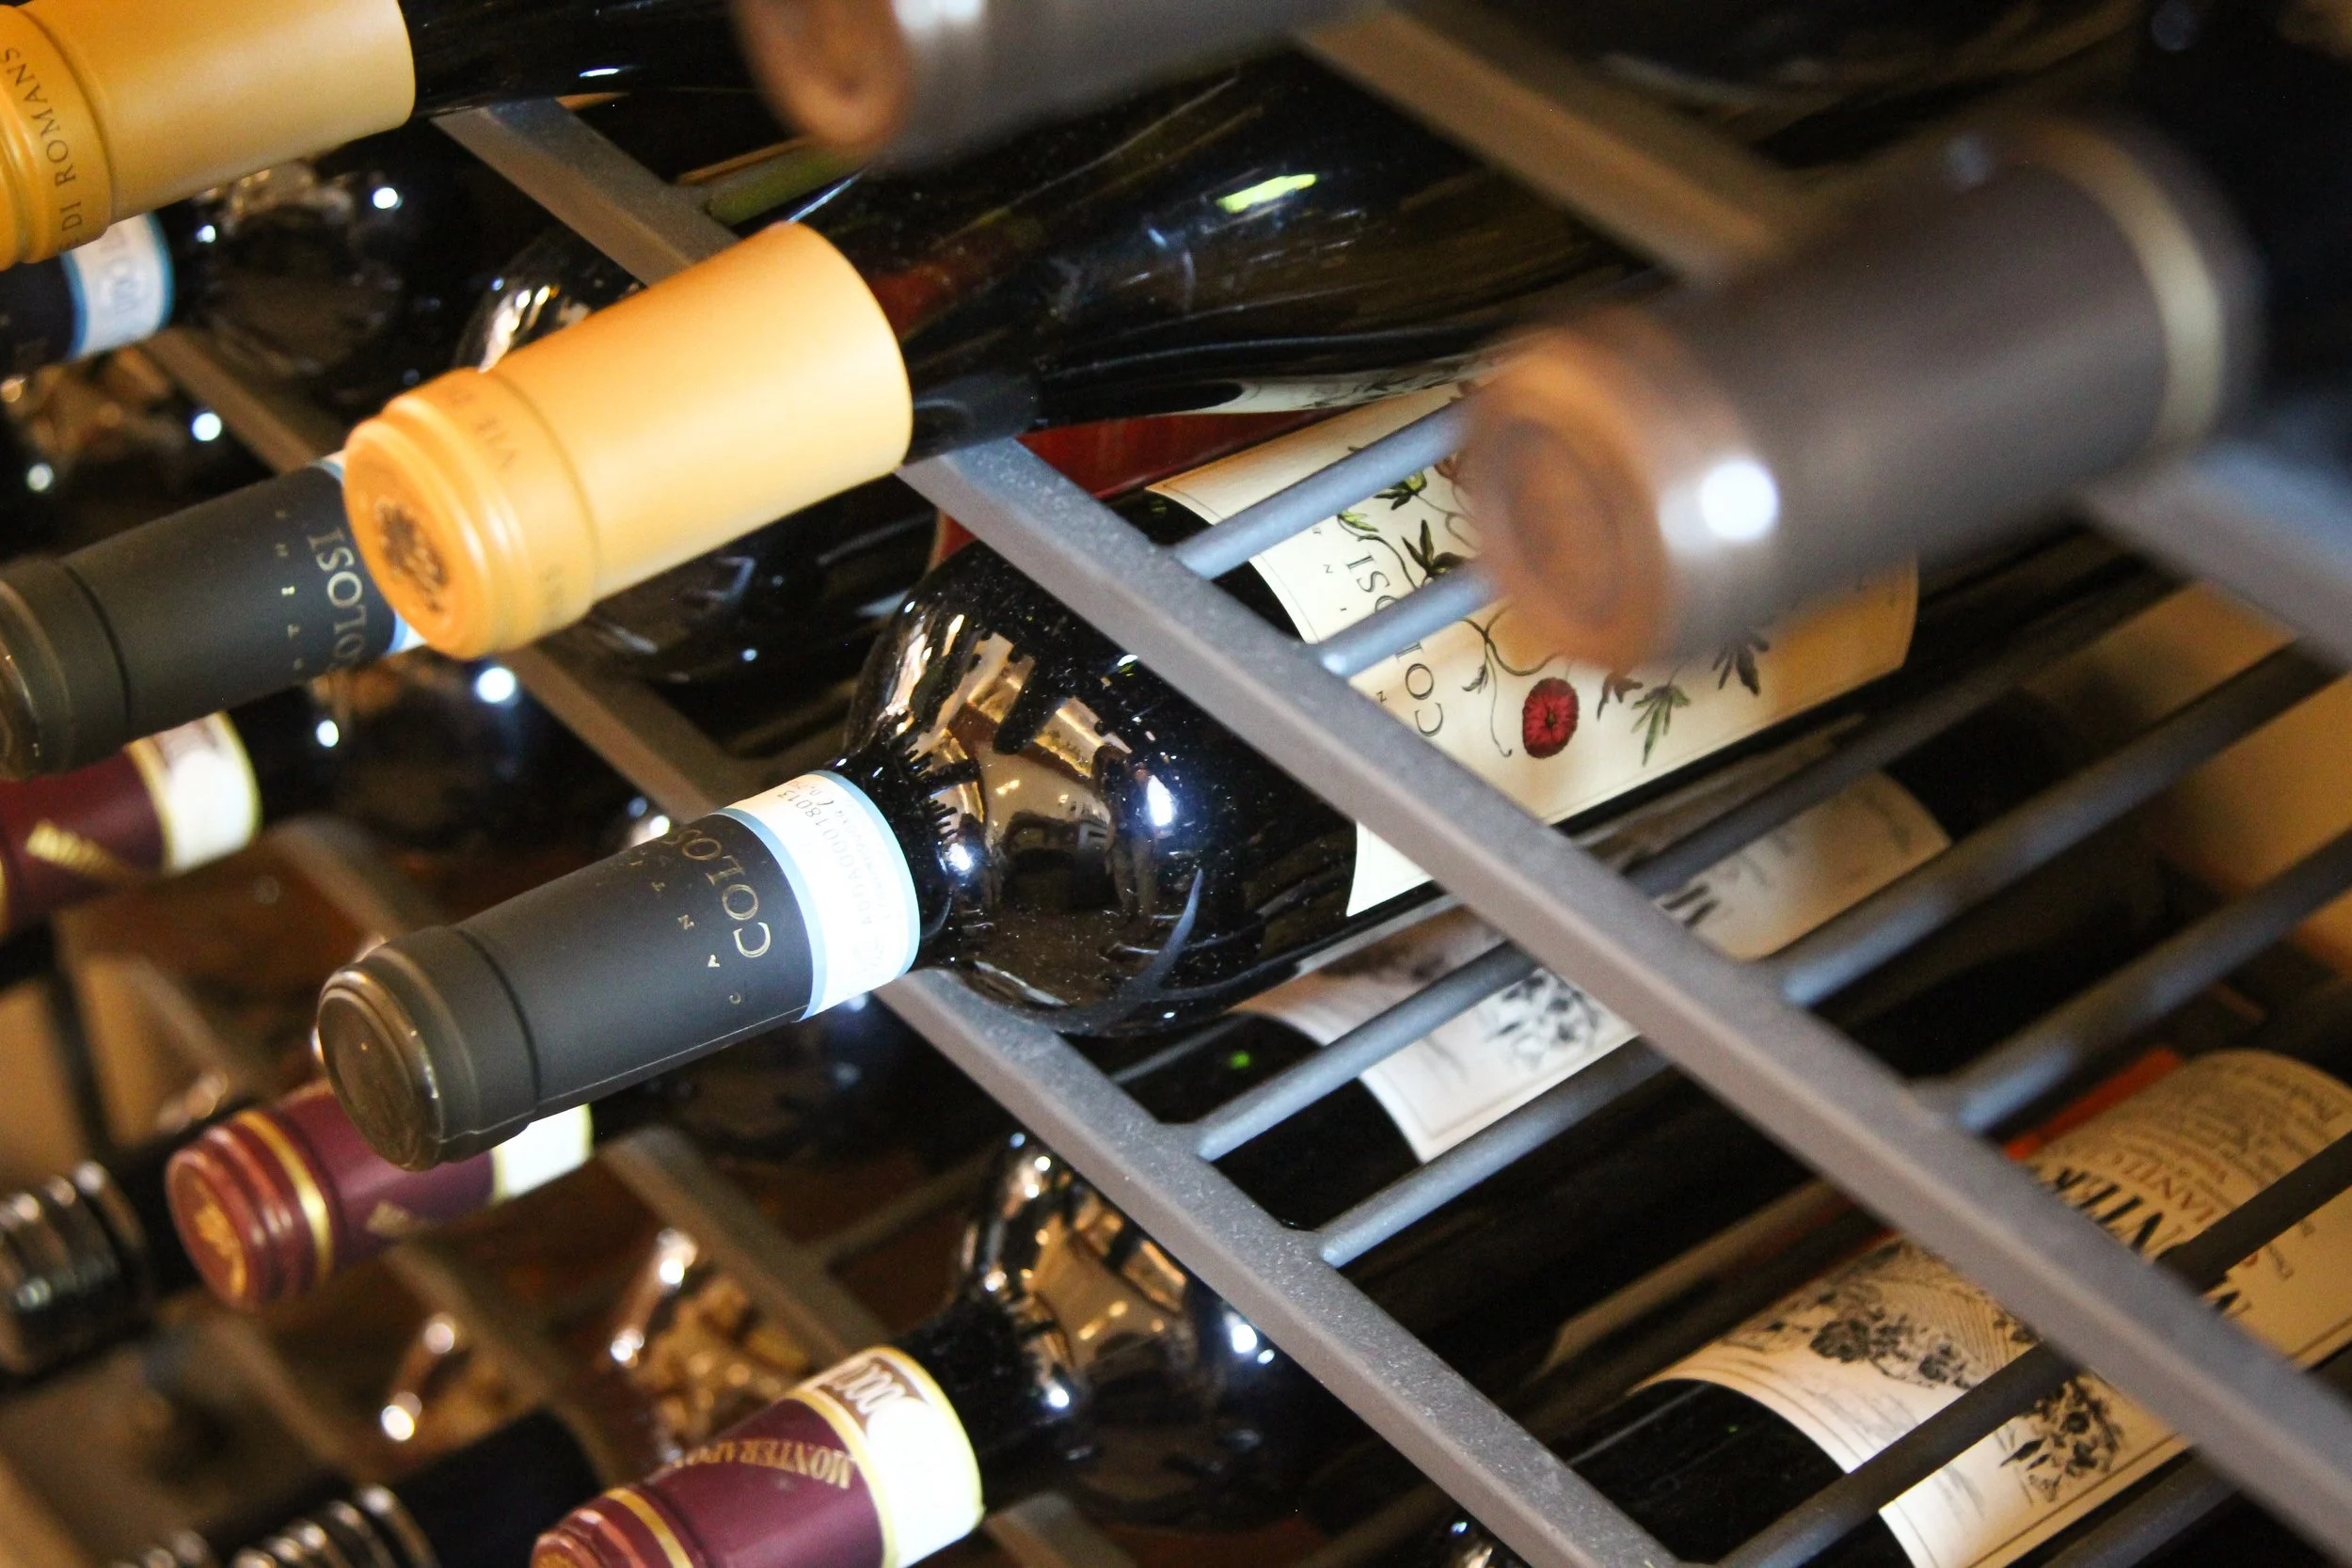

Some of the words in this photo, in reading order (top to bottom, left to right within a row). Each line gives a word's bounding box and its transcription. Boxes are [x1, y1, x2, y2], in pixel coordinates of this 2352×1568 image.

[0, 47, 76, 187] ROMANS
[60, 201, 83, 231] DI
[307, 527, 368, 662] OLOSI
